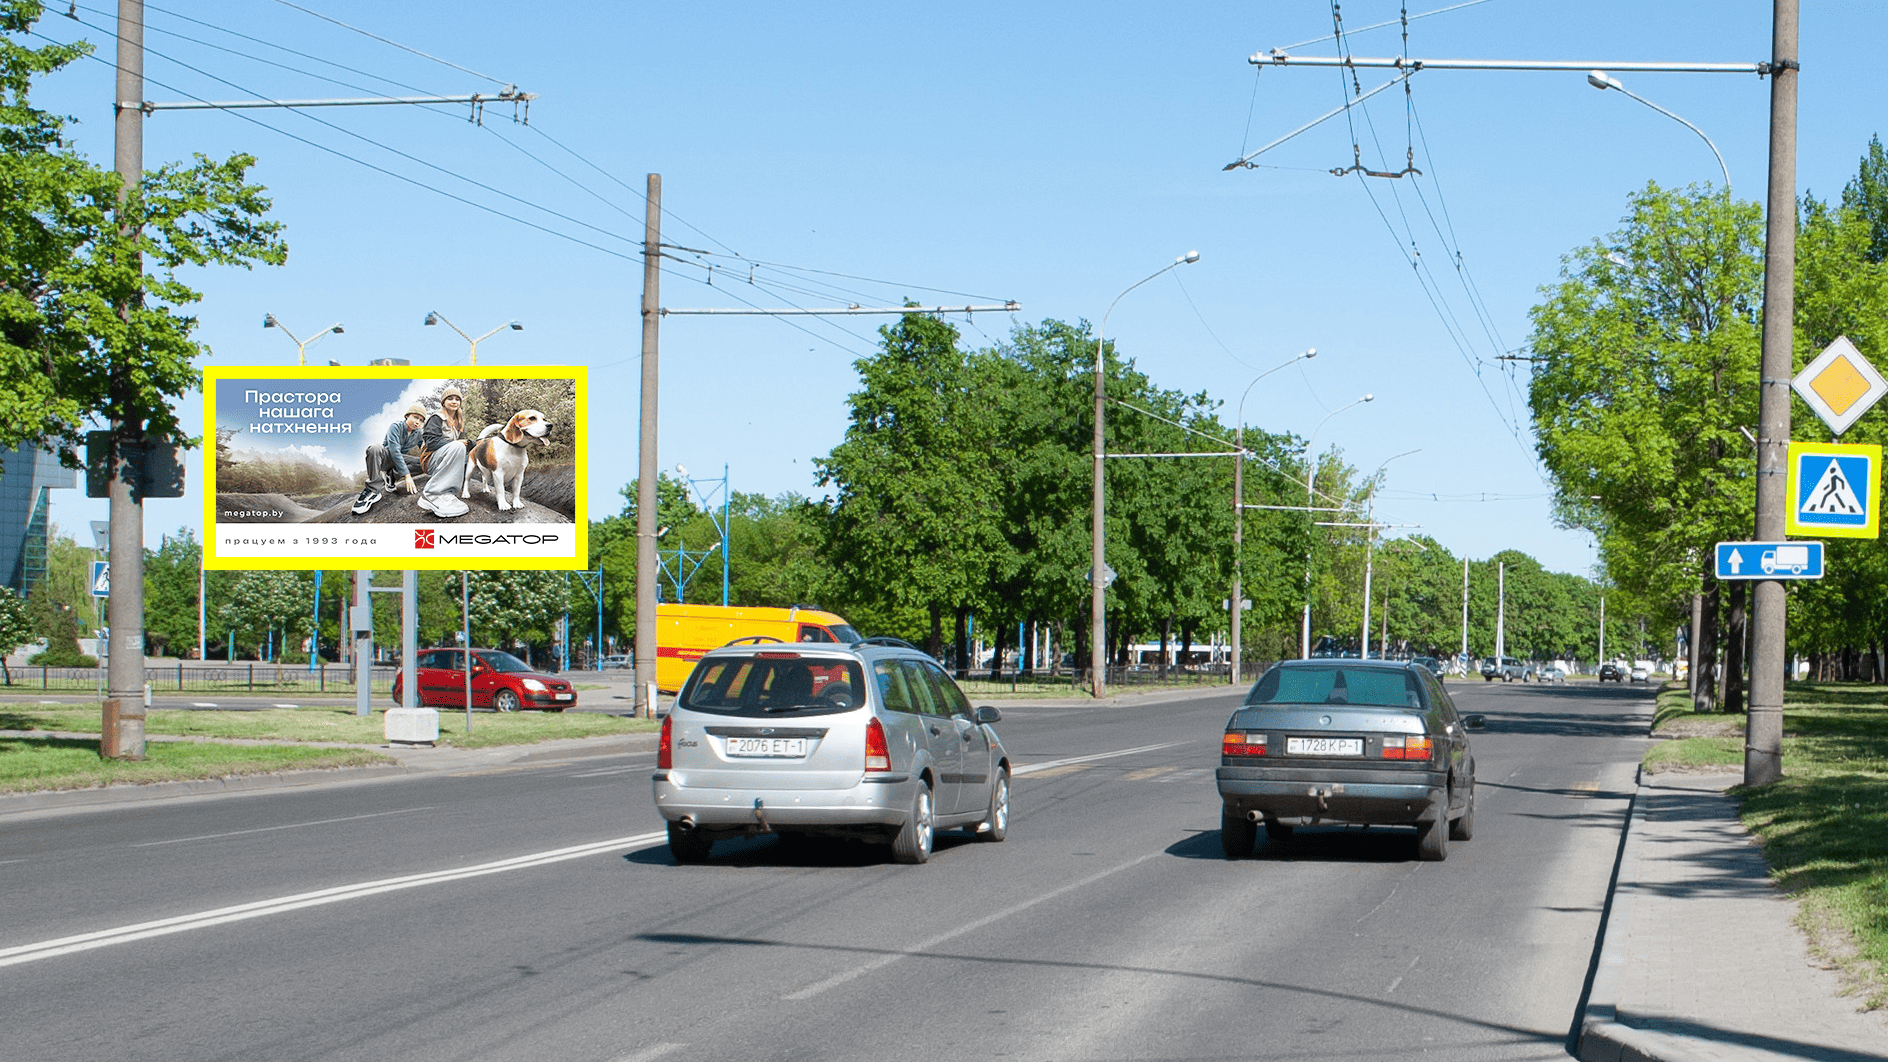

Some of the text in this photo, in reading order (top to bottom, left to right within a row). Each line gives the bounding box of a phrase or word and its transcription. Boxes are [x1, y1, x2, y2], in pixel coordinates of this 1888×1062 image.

[245, 389, 341, 405] Прастора
[259, 407, 334, 418] нашага
[249, 422, 352, 434] натхнення
[224, 509, 284, 518] megatop.by
[225, 537, 286, 546] працуем
[305, 537, 338, 545] 1993
[345, 538, 377, 546] года
[439, 534, 559, 545] MEGATOP
[739, 739, 768, 752] 2076
